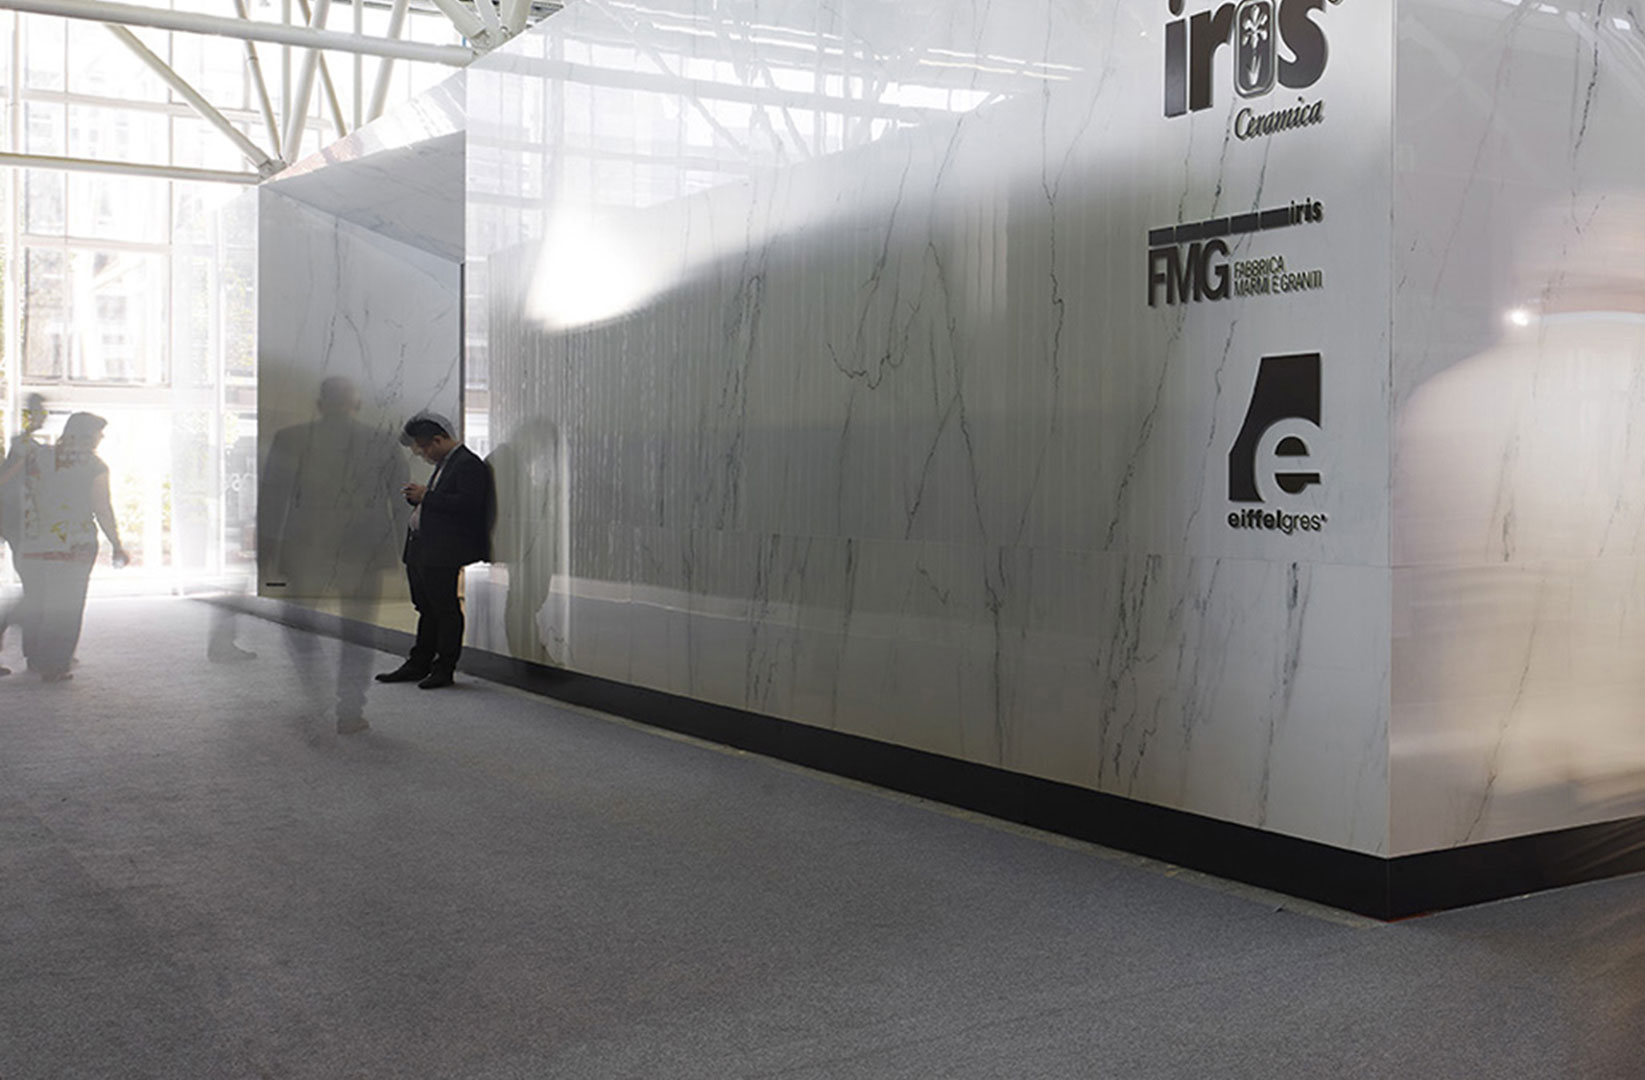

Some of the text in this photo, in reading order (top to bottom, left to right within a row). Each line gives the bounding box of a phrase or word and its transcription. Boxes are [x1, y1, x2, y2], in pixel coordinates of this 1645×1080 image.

[1234, 96, 1324, 141] Ceramica
[1290, 198, 1323, 226] iris
[1148, 238, 1231, 308] FMG
[1234, 256, 1285, 279] FABBRICA
[1234, 277, 1270, 297] MARMI
[1272, 276, 1281, 294] E
